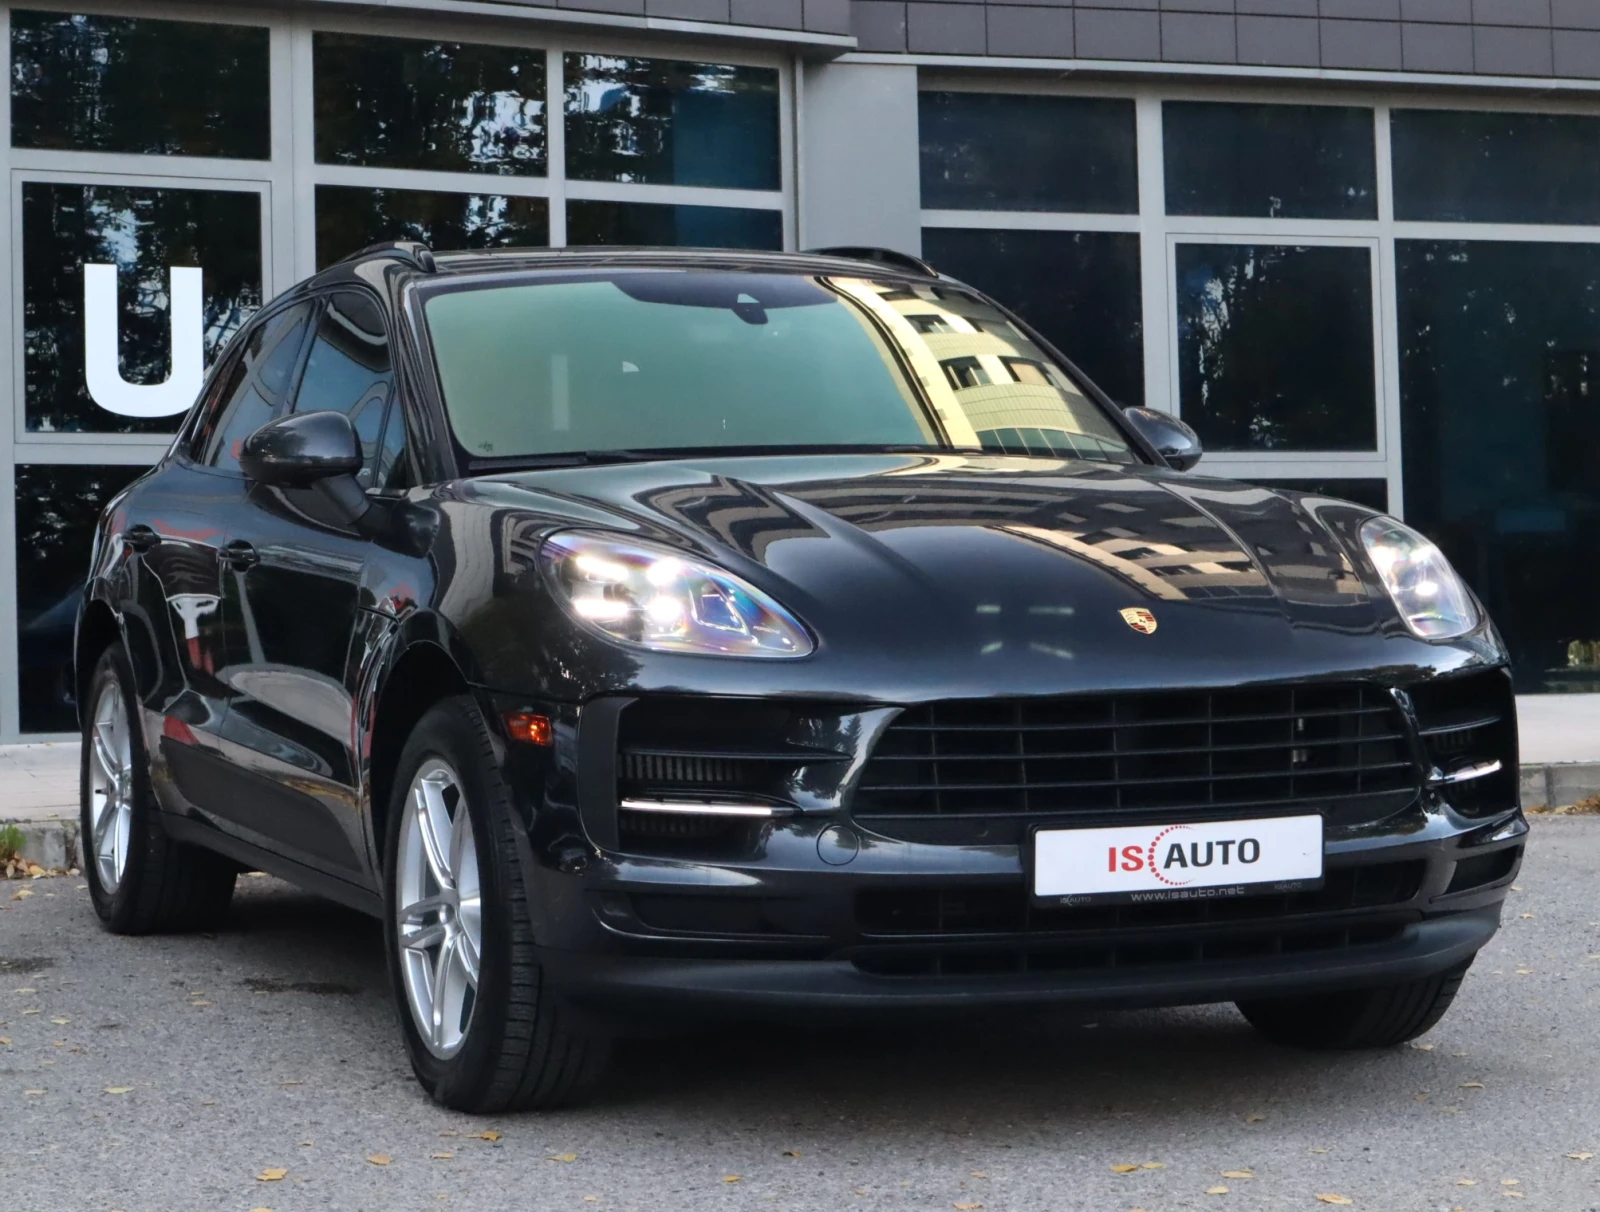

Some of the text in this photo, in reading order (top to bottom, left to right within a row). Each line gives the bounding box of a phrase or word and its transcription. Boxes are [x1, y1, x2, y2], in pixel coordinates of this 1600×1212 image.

[84, 263, 203, 417] U
[1108, 838, 1260, 872] IS AUTO
[1130, 885, 1245, 901] www.isauto.net
